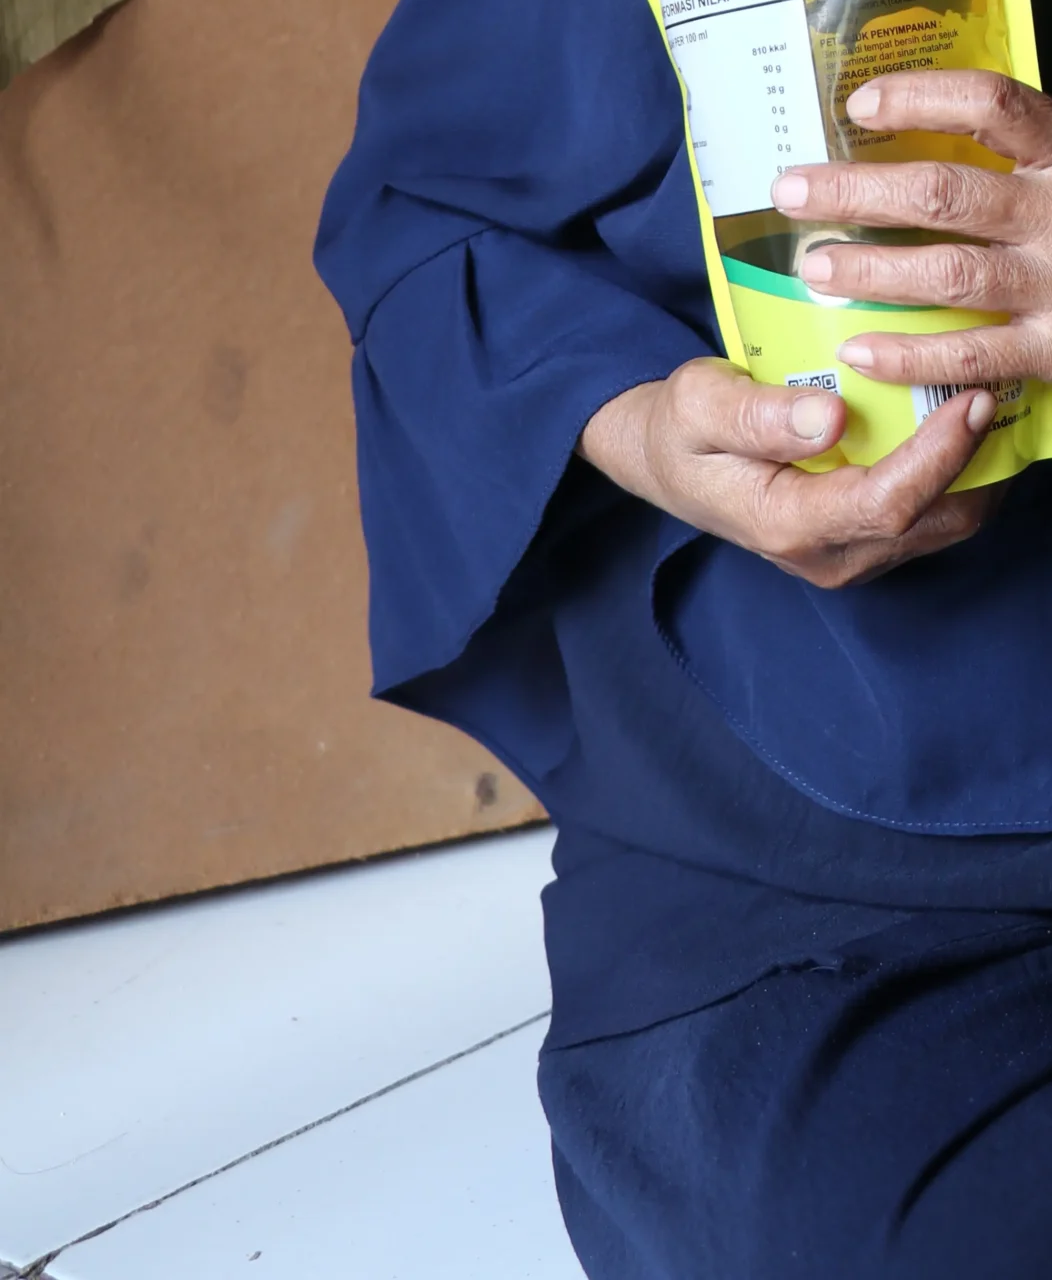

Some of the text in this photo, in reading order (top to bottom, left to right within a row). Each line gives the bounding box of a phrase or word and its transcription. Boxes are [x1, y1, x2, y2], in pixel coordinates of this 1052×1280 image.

[870, 20, 938, 39] PENYIMPANAN
[685, 32, 697, 44] 100
[855, 44, 862, 54] di
[864, 40, 893, 53] tempat
[895, 34, 920, 47] bersih
[922, 32, 936, 43] dan
[938, 29, 959, 42] sejuk
[752, 42, 787, 56] 810 kkal
[841, 53, 877, 68] terhindar
[879, 49, 895, 61] dari
[896, 48, 917, 58] sinar
[919, 41, 953, 54] matahari
[763, 64, 781, 73] 90 g
[826, 67, 870, 82] STORAGE
[872, 57, 933, 75] SUGGESTION
[766, 85, 784, 95] 38 g
[771, 106, 785, 115] 0 g
[774, 125, 788, 134] 0 g
[858, 134, 897, 146] kemasan
[777, 144, 791, 152] 0 g
